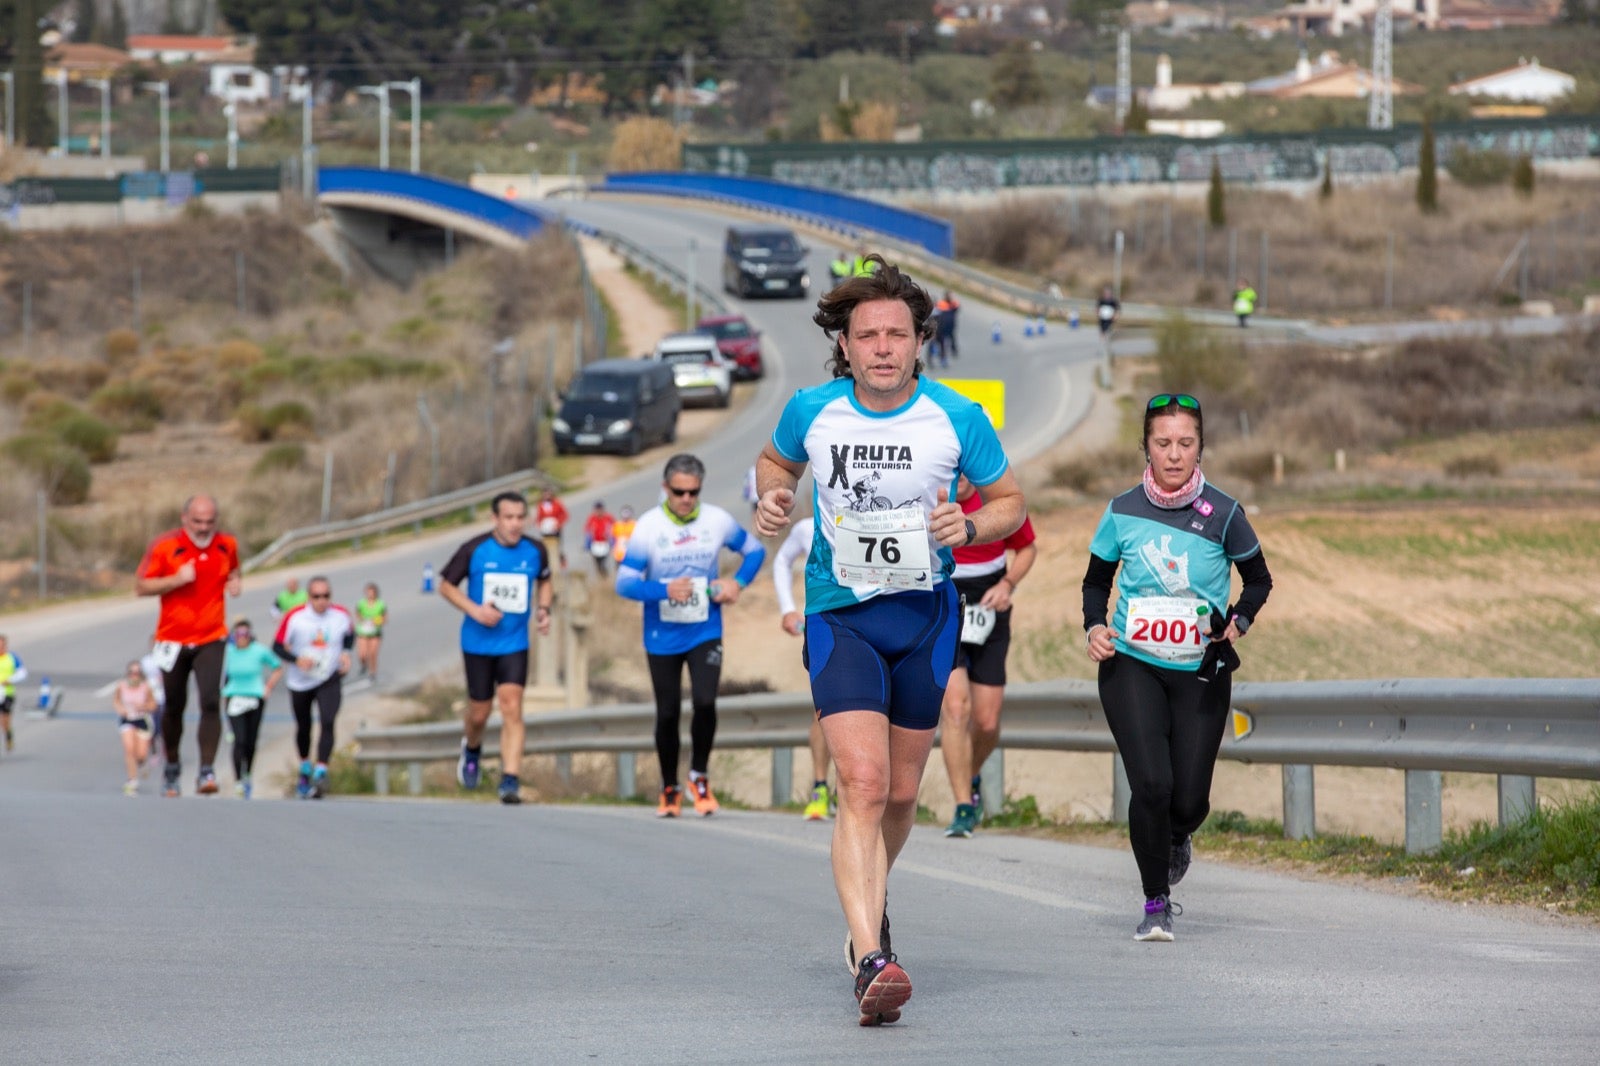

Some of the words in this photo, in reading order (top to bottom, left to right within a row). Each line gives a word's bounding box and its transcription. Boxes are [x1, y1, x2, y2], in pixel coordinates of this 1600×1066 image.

[828, 444, 850, 490] X
[853, 445, 913, 461] RUTA
[852, 462, 912, 470] CICLOTURISTA
[858, 536, 901, 564] 76
[492, 585, 519, 599] 492
[1131, 618, 1201, 645] 2001
